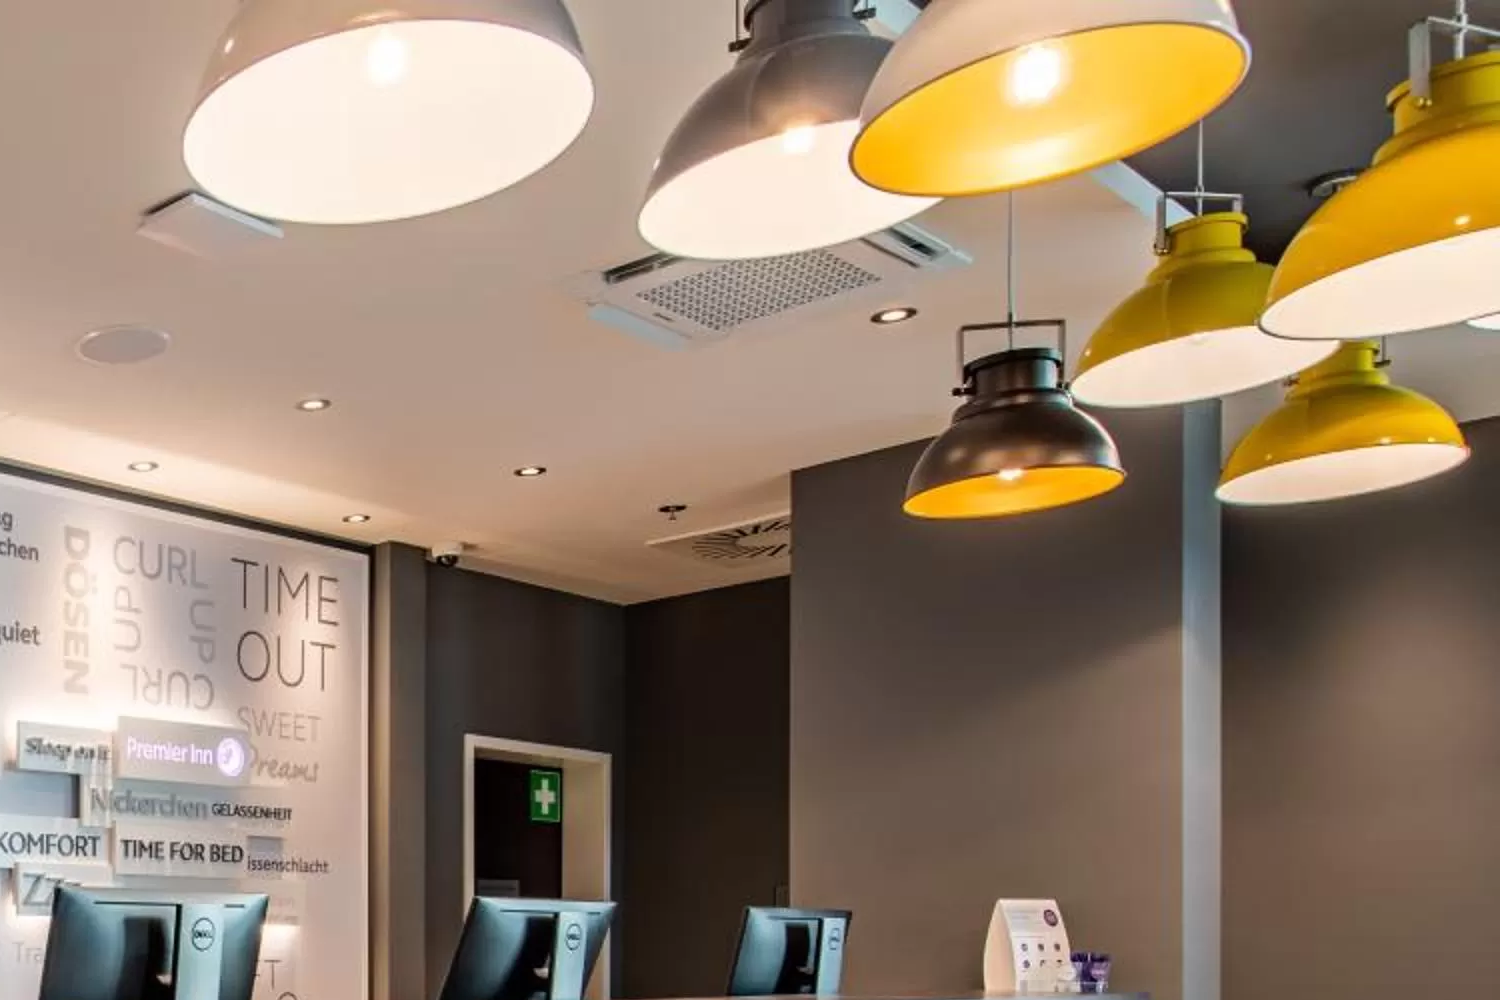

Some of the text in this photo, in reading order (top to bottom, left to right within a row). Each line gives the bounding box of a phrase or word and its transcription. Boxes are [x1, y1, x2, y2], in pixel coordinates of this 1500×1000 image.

[113, 536, 209, 591] CURL
[231, 557, 340, 627] TIME
[237, 631, 337, 692] OUT
[237, 705, 322, 743] SWEET
[127, 736, 213, 765] Premier Inn
[212, 802, 292, 822] GELASSENHEIT
[121, 839, 244, 863] TIME FOR BED
[247, 856, 330, 874] issenschlacht
